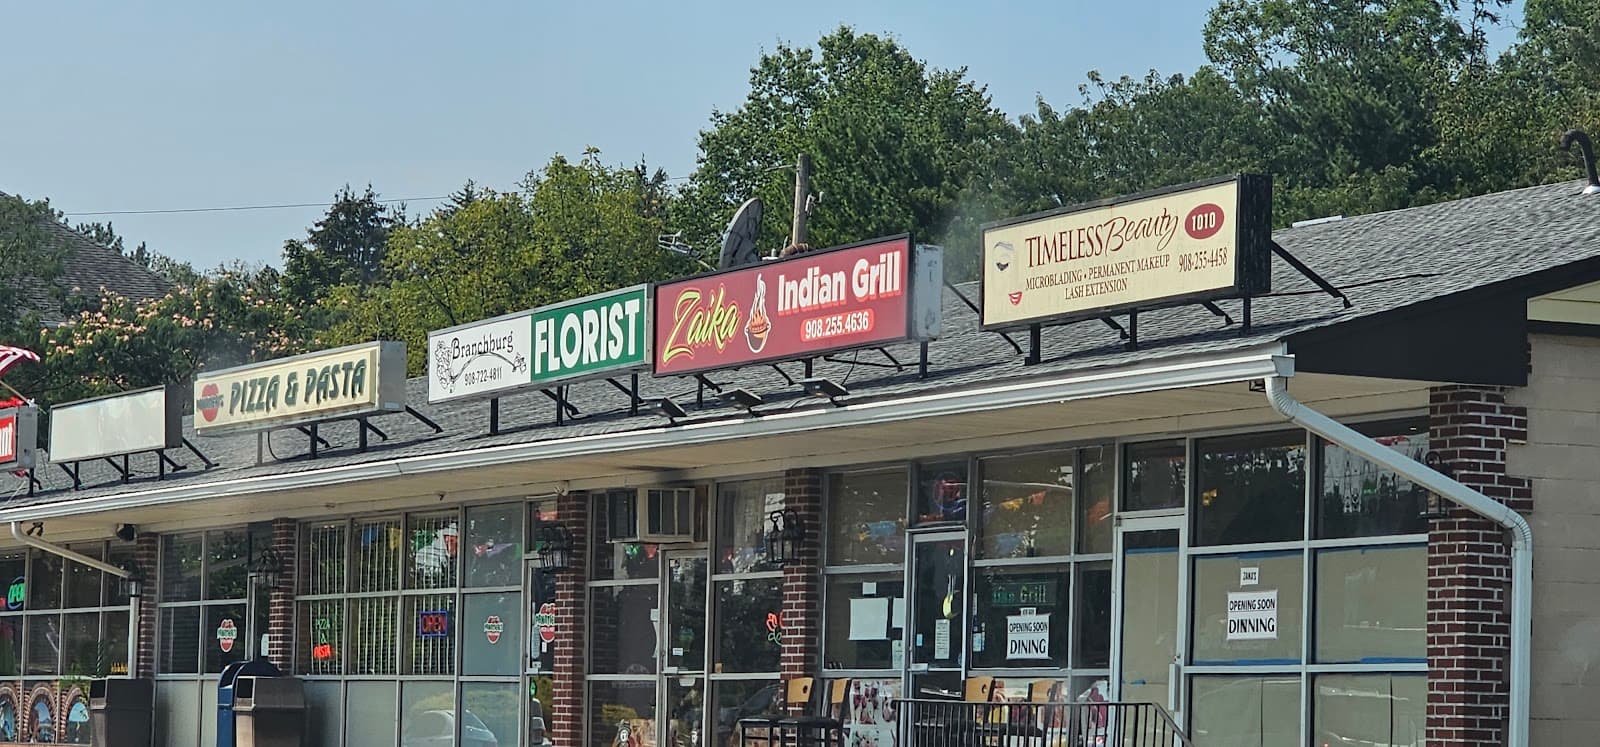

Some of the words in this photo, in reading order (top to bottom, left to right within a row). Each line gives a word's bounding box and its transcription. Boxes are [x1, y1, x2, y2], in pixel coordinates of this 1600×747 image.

[1191, 211, 1216, 232] 1010
[1025, 224, 1103, 268] TIMELESS
[1102, 207, 1179, 257] Beauty
[777, 266, 846, 313] Indian
[851, 251, 901, 299] Grill
[1025, 270, 1083, 291] MICROBLADING
[1088, 260, 1135, 281] PERMANENT
[1137, 254, 1171, 272] MAKEUP
[1065, 287, 1084, 300] LASH
[1085, 278, 1128, 297] EXTENSION
[534, 298, 640, 375] FLORIST
[663, 288, 740, 363] Zaika
[804, 313, 870, 340] 908.255.4636
[450, 330, 514, 360] Branchburg
[228, 374, 281, 416] PIZZA
[284, 371, 299, 406] &
[303, 358, 368, 404] PASTA
[464, 366, 503, 386] 908-722-4811
[1229, 599, 1257, 611] OPENING
[1257, 598, 1275, 609] SOON
[422, 614, 447, 632] OPEN
[1009, 622, 1033, 633] OPENING
[1033, 621, 1048, 632] SOON
[1229, 617, 1275, 633] DINNING
[1010, 638, 1046, 654] DINING
